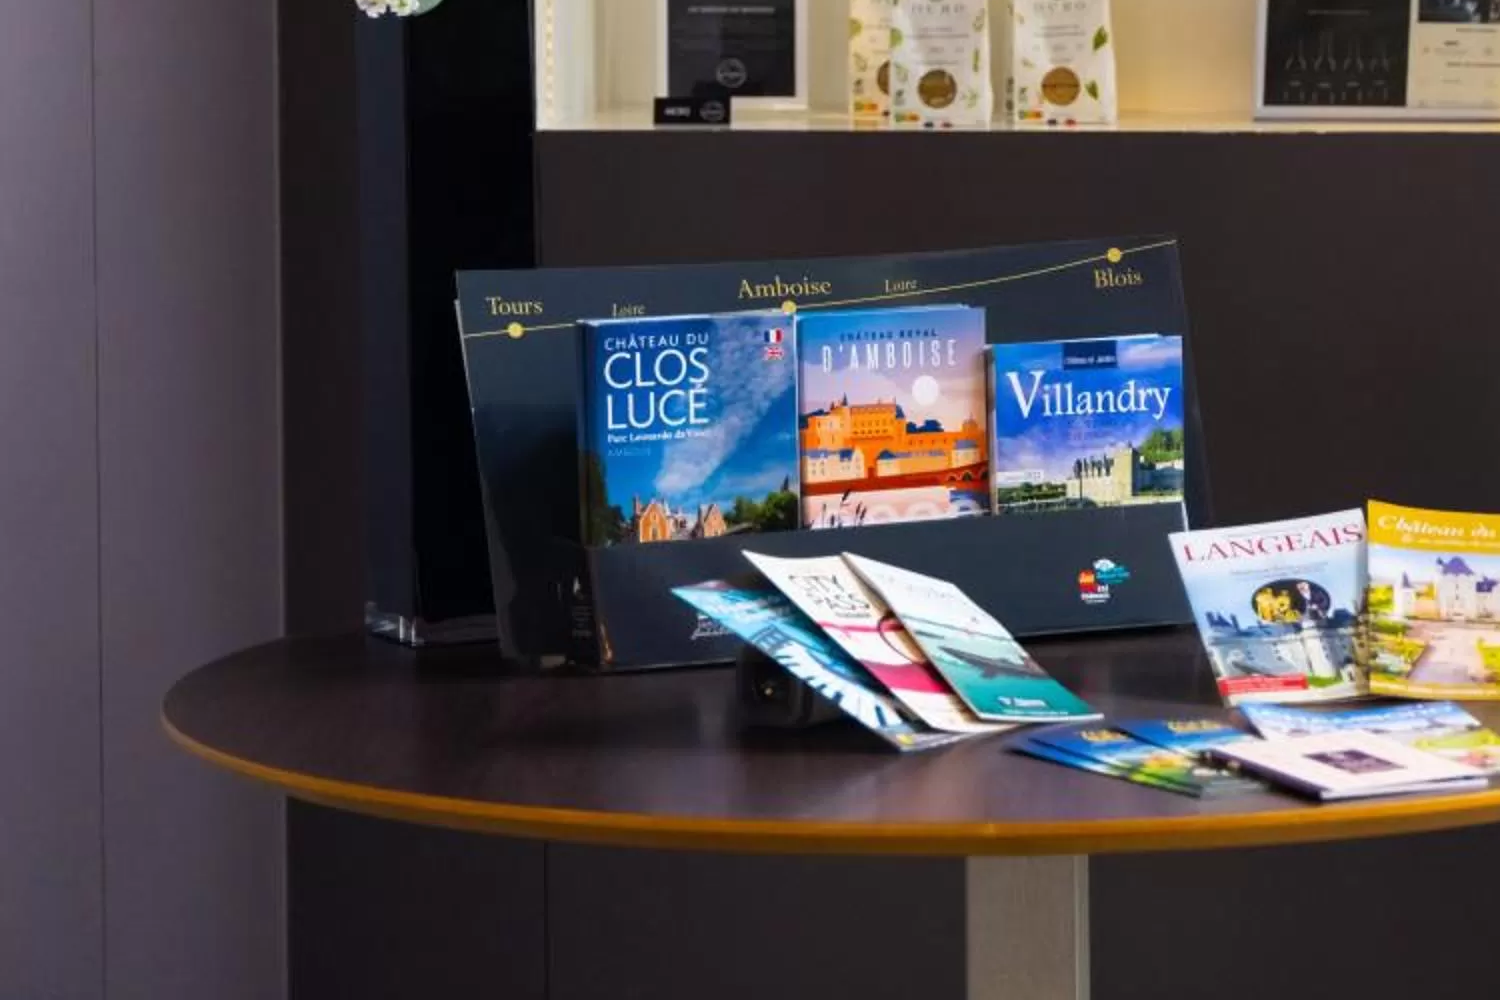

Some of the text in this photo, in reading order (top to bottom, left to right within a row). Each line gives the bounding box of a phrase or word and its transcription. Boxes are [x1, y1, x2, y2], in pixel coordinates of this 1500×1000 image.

[738, 274, 833, 299] Amboise
[1095, 267, 1143, 289] Blois
[485, 296, 544, 316] Tours
[604, 332, 709, 351] CHÂTEAU DU
[821, 339, 957, 373] D'AMBOISE
[604, 347, 709, 389] CLOS
[1006, 370, 1172, 420] Villandry
[1183, 523, 1365, 562] LANGEAIS
